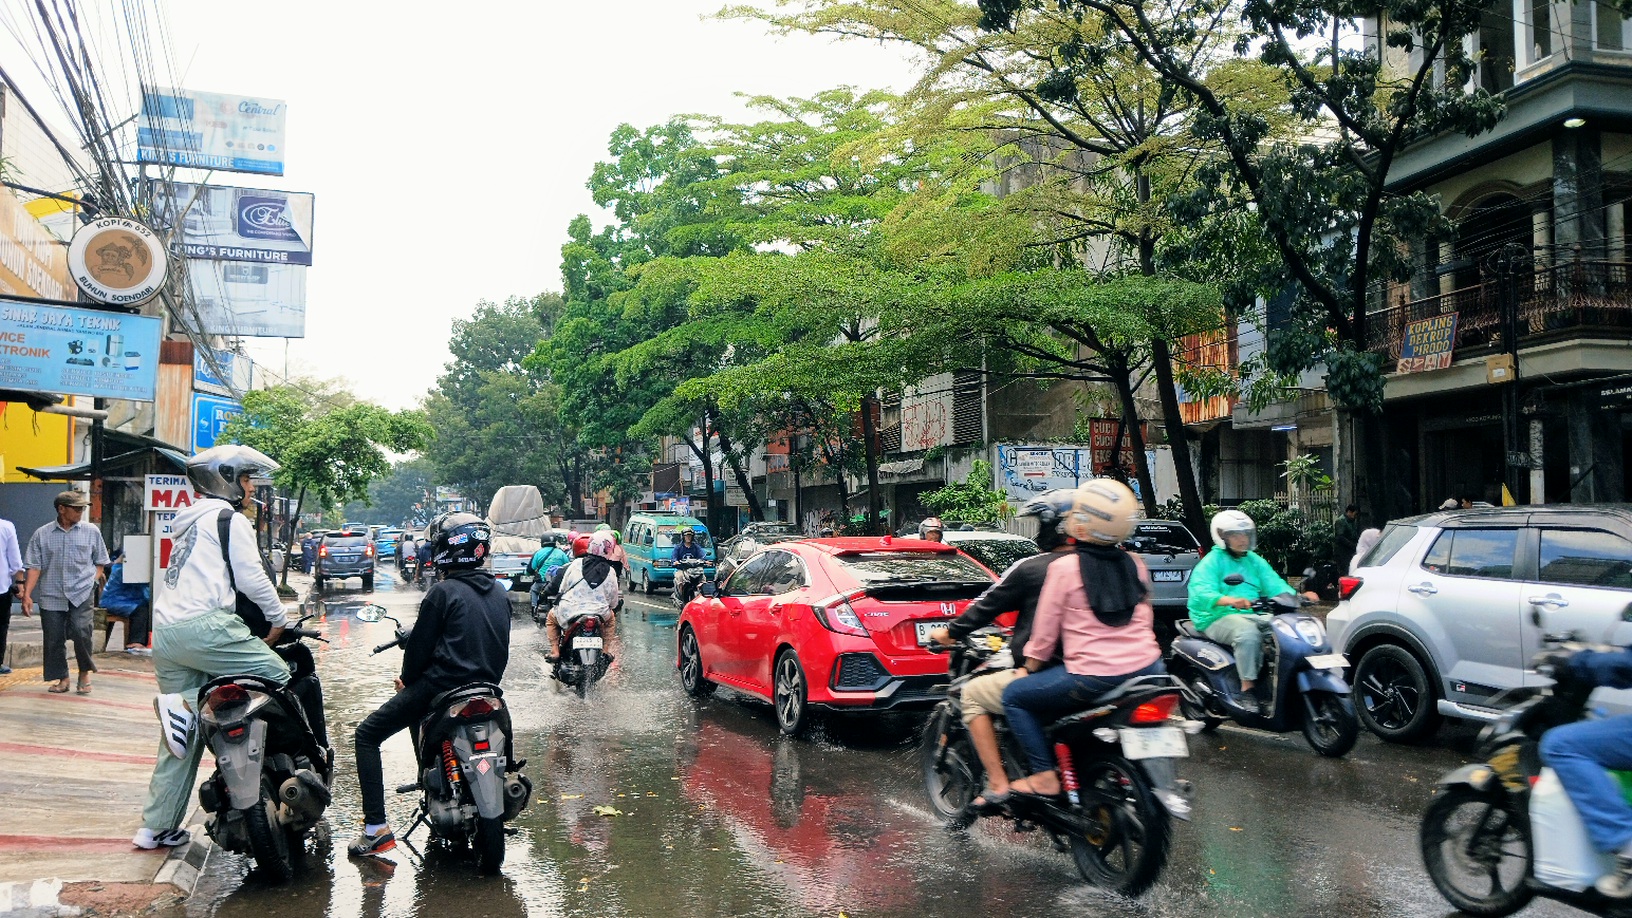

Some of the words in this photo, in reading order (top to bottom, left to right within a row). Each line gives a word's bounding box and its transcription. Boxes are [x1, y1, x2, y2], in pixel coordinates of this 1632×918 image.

[238, 101, 280, 115] Central
[180, 152, 235, 168] FURNITURE
[96, 219, 120, 229] KOPI
[134, 225, 152, 238] 652
[219, 248, 288, 262] FURNITURE
[79, 275, 108, 299] BUHUN
[111, 286, 155, 302] SOENDARI
[2, 308, 38, 324] SINAR
[41, 313, 74, 328] JAYA
[78, 315, 122, 332] TEKNIK
[1408, 316, 1453, 336] KOPLING
[1409, 328, 1451, 346] DEKRUP
[0, 344, 50, 358] TRONIK
[1412, 340, 1450, 357] PIRODO
[1094, 422, 1114, 435] CUCI
[1094, 434, 1113, 447] CUCI
[149, 477, 186, 485] TERIMA
[157, 513, 176, 521] TER
